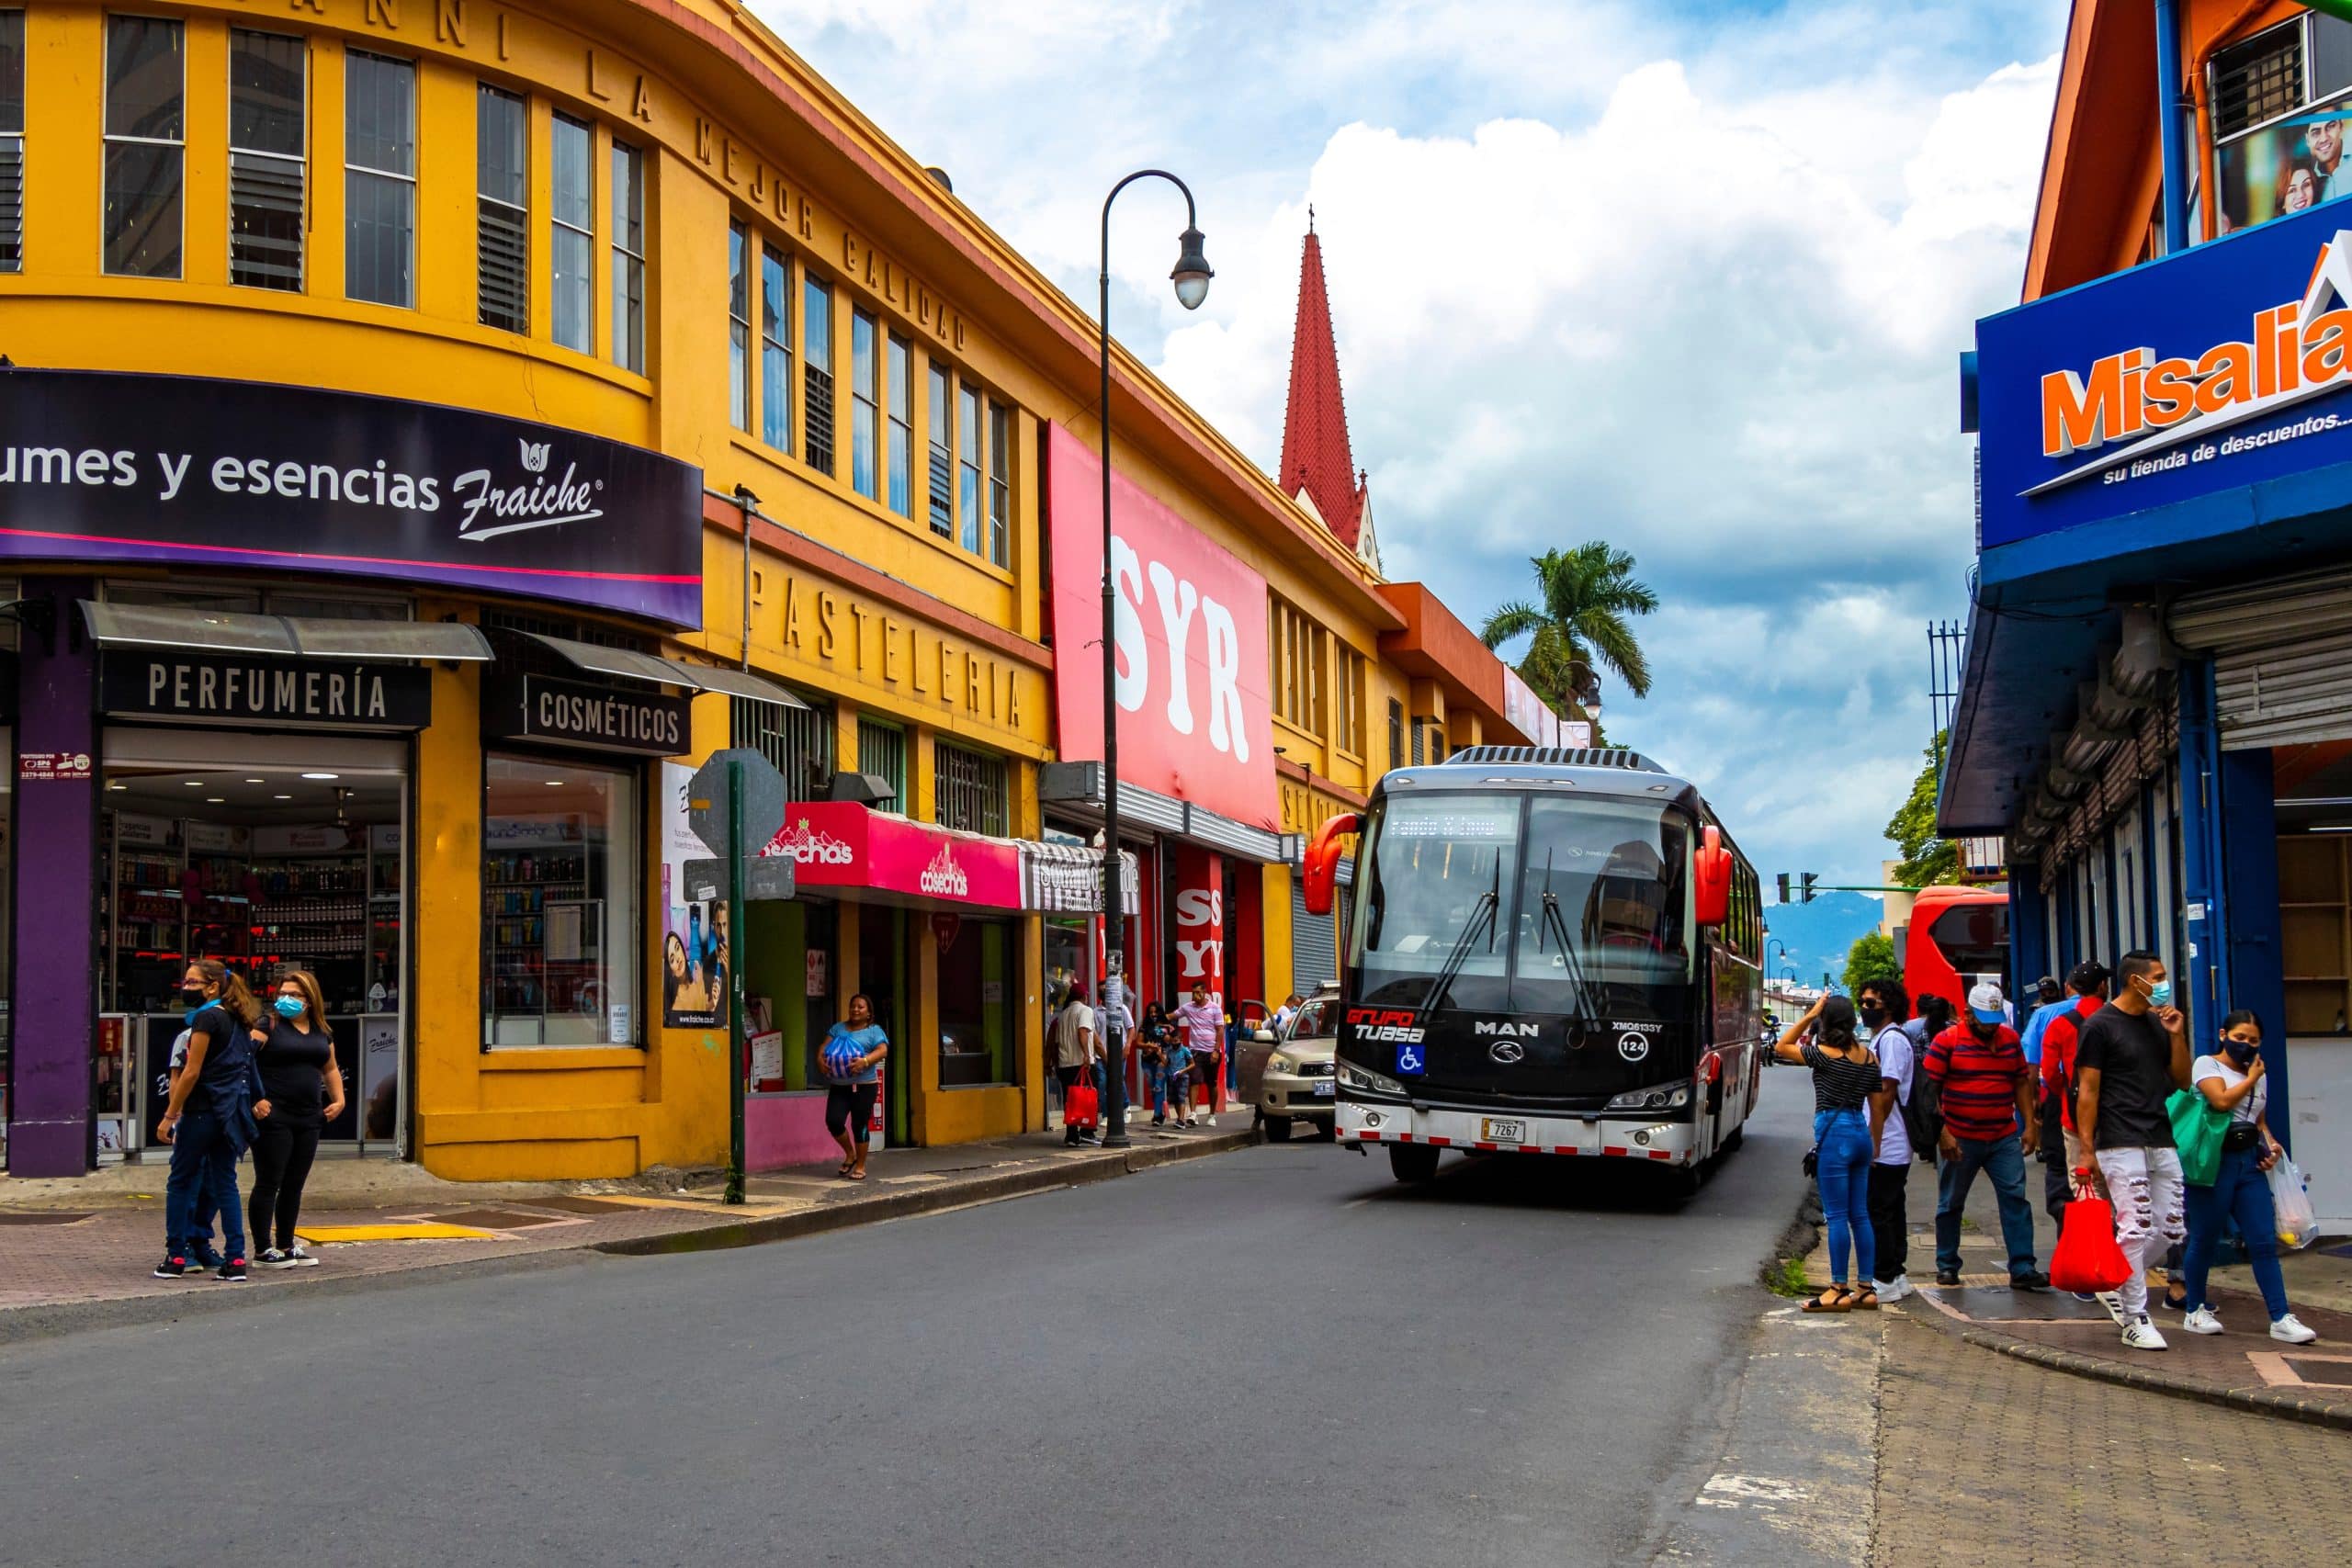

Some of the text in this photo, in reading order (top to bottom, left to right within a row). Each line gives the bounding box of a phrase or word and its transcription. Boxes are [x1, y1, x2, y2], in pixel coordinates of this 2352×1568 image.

[587, 51, 651, 122] LA
[695, 118, 813, 240] MEJOR
[843, 231, 965, 352] CALIDAD
[0, 446, 440, 513] umes y esencias
[2103, 468, 2127, 485] su
[2130, 451, 2188, 479] tienda
[2191, 444, 2216, 463] de
[747, 568, 1021, 728] PASTELERIA
[1101, 535, 1250, 764] SYR
[148, 662, 386, 718] PERFUMERÍA
[539, 691, 680, 745] COSMÉTICOS
[920, 862, 968, 897] cosechas
[1475, 1021, 1540, 1037] MAN
[1611, 1021, 1663, 1033] XMQ6133Y
[1622, 1041, 1645, 1052] 124
[1494, 1123, 1519, 1137] 7267
